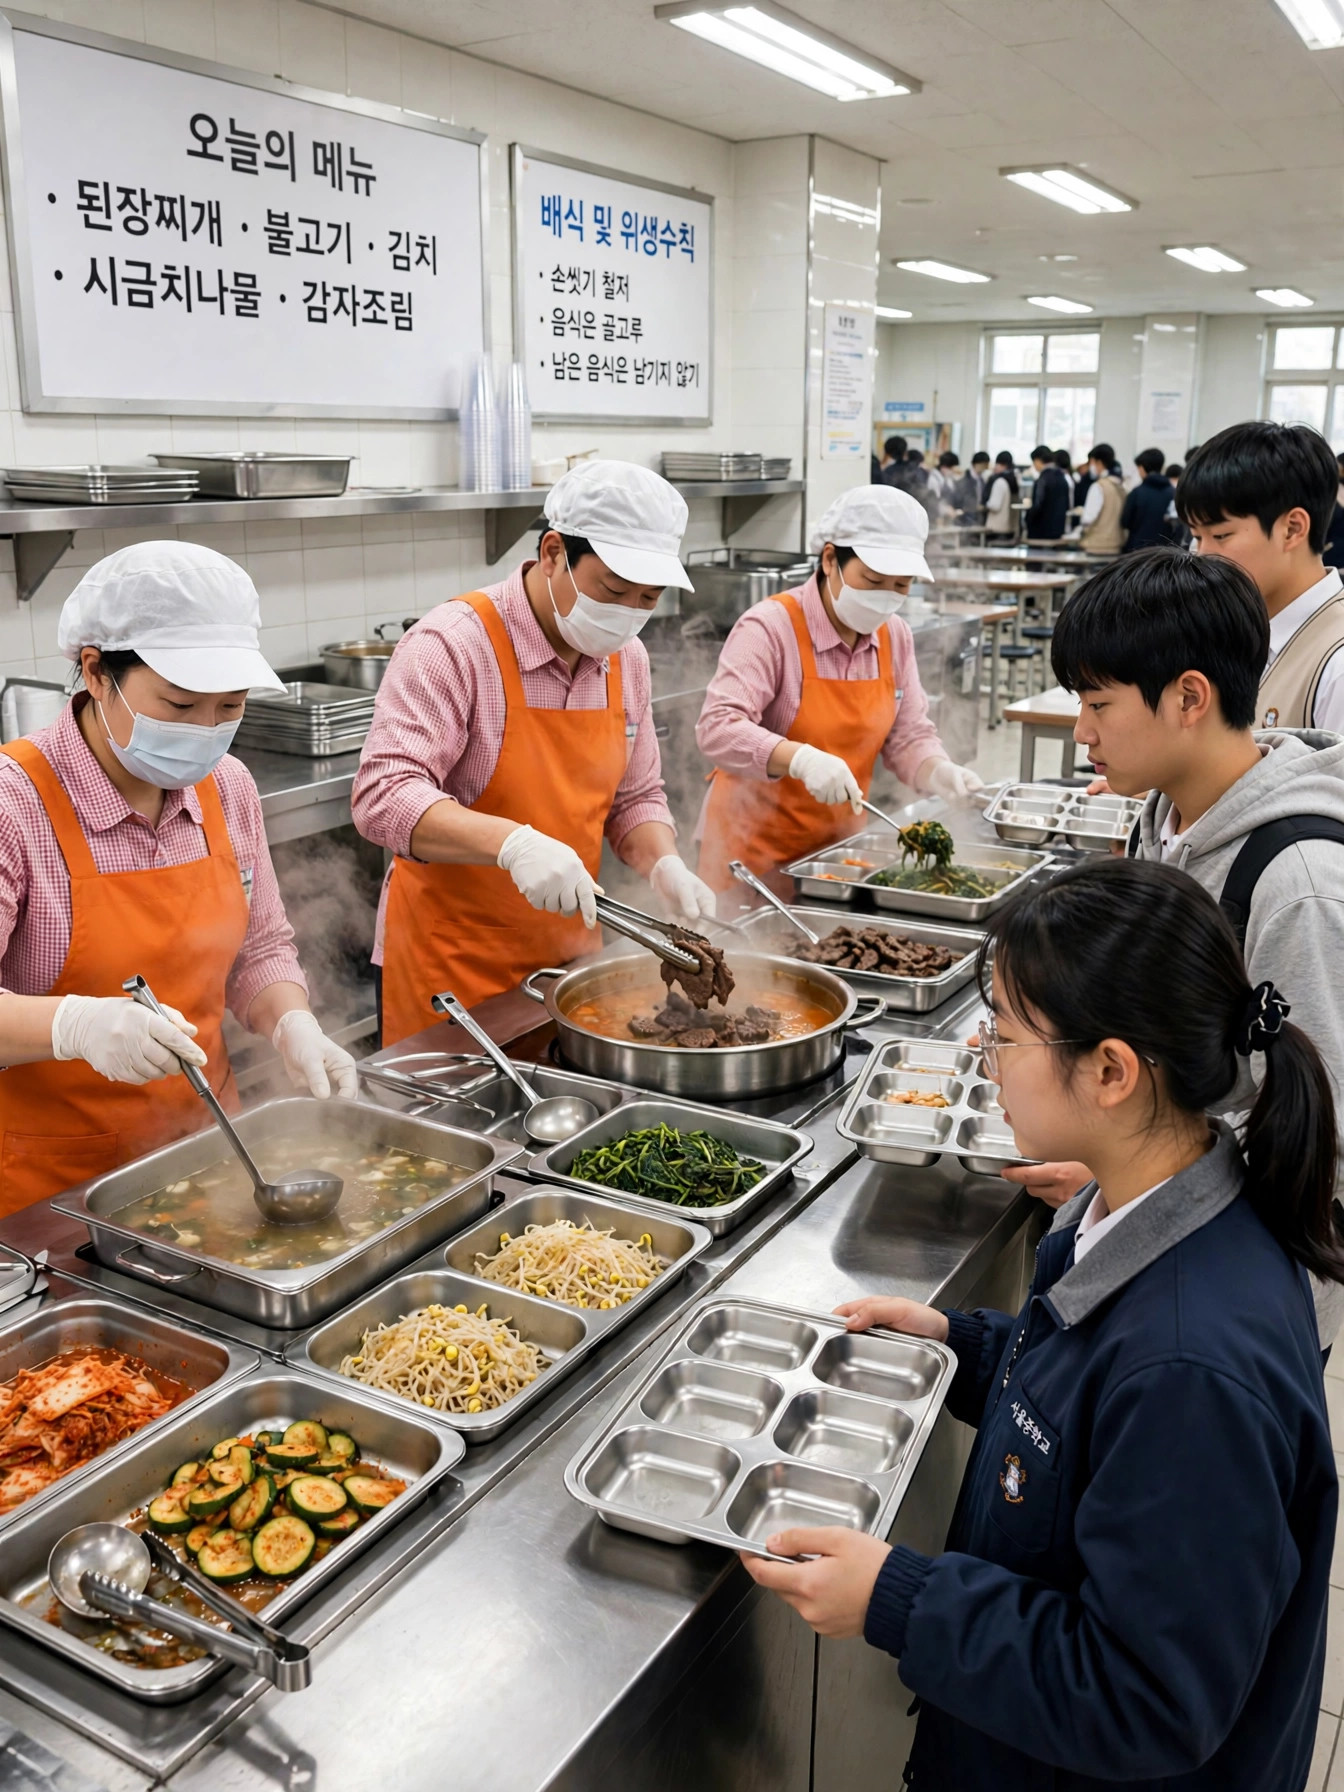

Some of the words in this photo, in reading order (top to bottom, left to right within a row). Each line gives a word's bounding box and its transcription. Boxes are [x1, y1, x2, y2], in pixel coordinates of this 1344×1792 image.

[186, 113, 296, 183] 오늘의
[312, 141, 376, 197] 메뉴
[77, 179, 222, 247] 된장찌개
[263, 209, 351, 264] 불고기
[388, 231, 436, 275] 김치
[541, 195, 583, 242] 배식
[594, 205, 611, 247] 및
[620, 211, 694, 263] 위생수칙
[84, 256, 261, 318] 시금치나물
[302, 281, 412, 331] 감자조림
[551, 264, 595, 297] 손씻기
[603, 271, 628, 302] 철저
[551, 308, 596, 339] 음식은
[602, 314, 643, 343] 골고루
[553, 352, 581, 380] 남은
[587, 354, 628, 383] 음식은
[634, 358, 670, 385] 남기지
[677, 362, 698, 387] 않기
